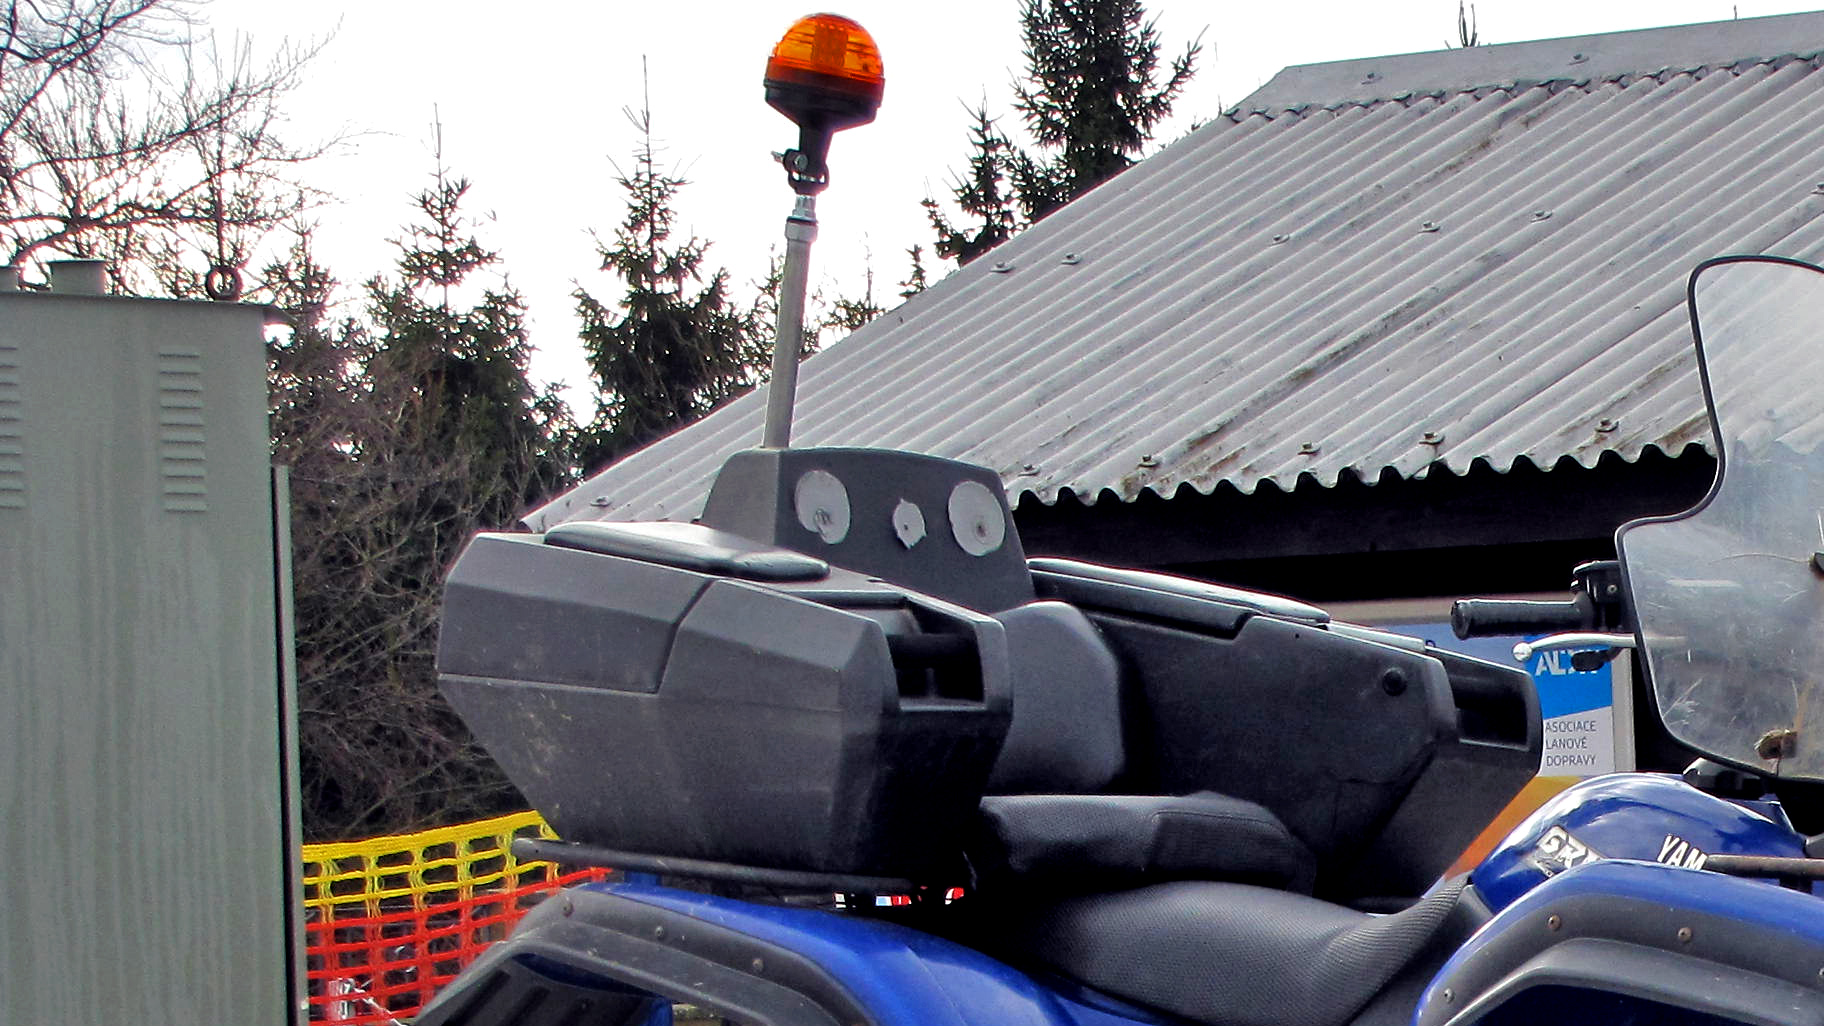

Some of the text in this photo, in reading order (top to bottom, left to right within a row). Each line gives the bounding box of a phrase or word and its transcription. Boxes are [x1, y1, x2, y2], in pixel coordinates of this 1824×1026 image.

[1535, 648, 1600, 676] AL
[1544, 720, 1597, 733] ASOCIACE
[1545, 736, 1588, 750] LANOVÉ
[1546, 754, 1597, 767] DOPRAVY
